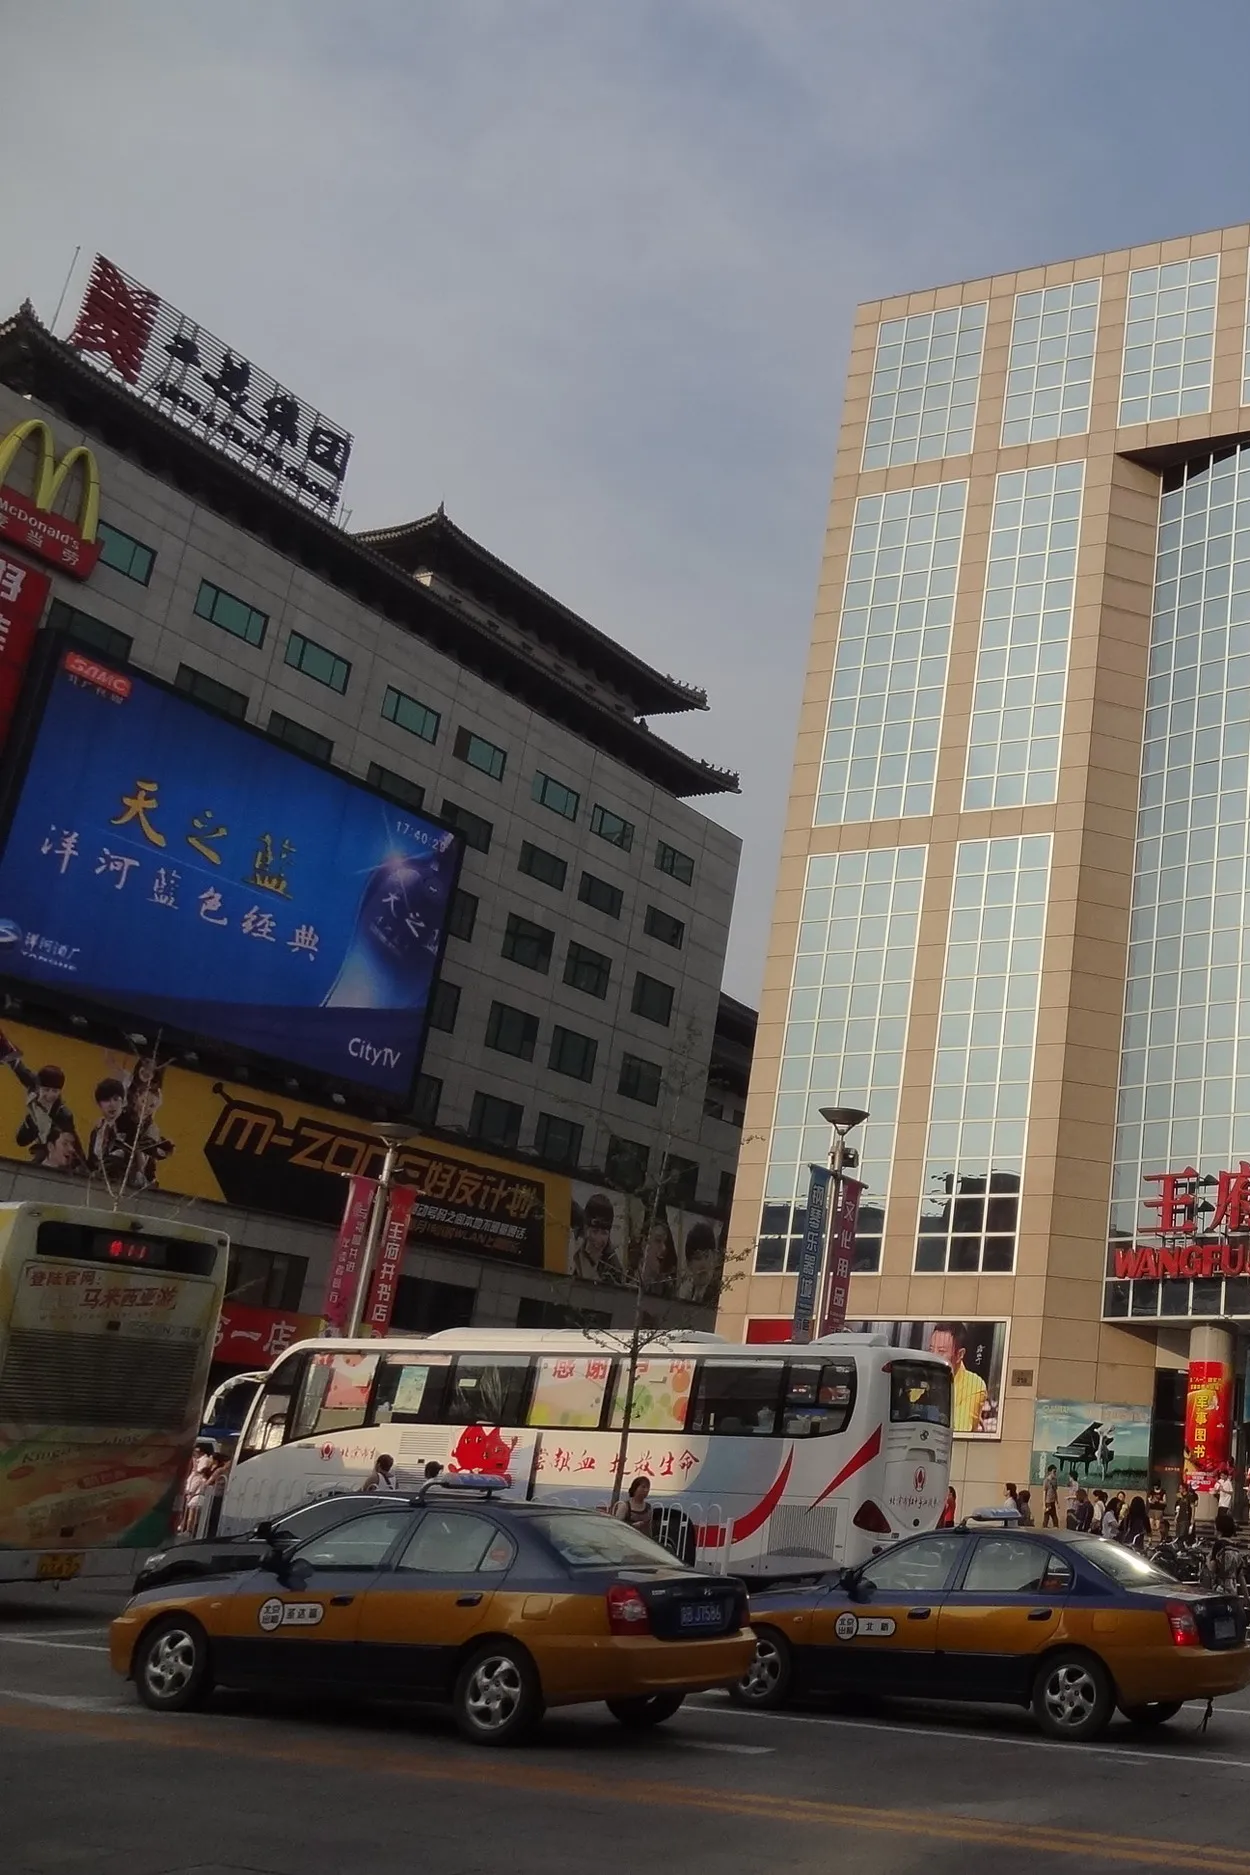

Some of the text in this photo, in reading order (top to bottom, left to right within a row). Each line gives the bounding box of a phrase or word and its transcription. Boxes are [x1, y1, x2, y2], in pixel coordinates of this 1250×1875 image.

[0, 497, 80, 552] McDonald's
[347, 1036, 402, 1069] CityTV
[370, 1220, 406, 1323] 王府井书店
[832, 1199, 856, 1308] 文化用品
[1193, 1394, 1209, 1459] 军事图书
[838, 1626, 854, 1635] 出租
[839, 1618, 855, 1626] 北京
